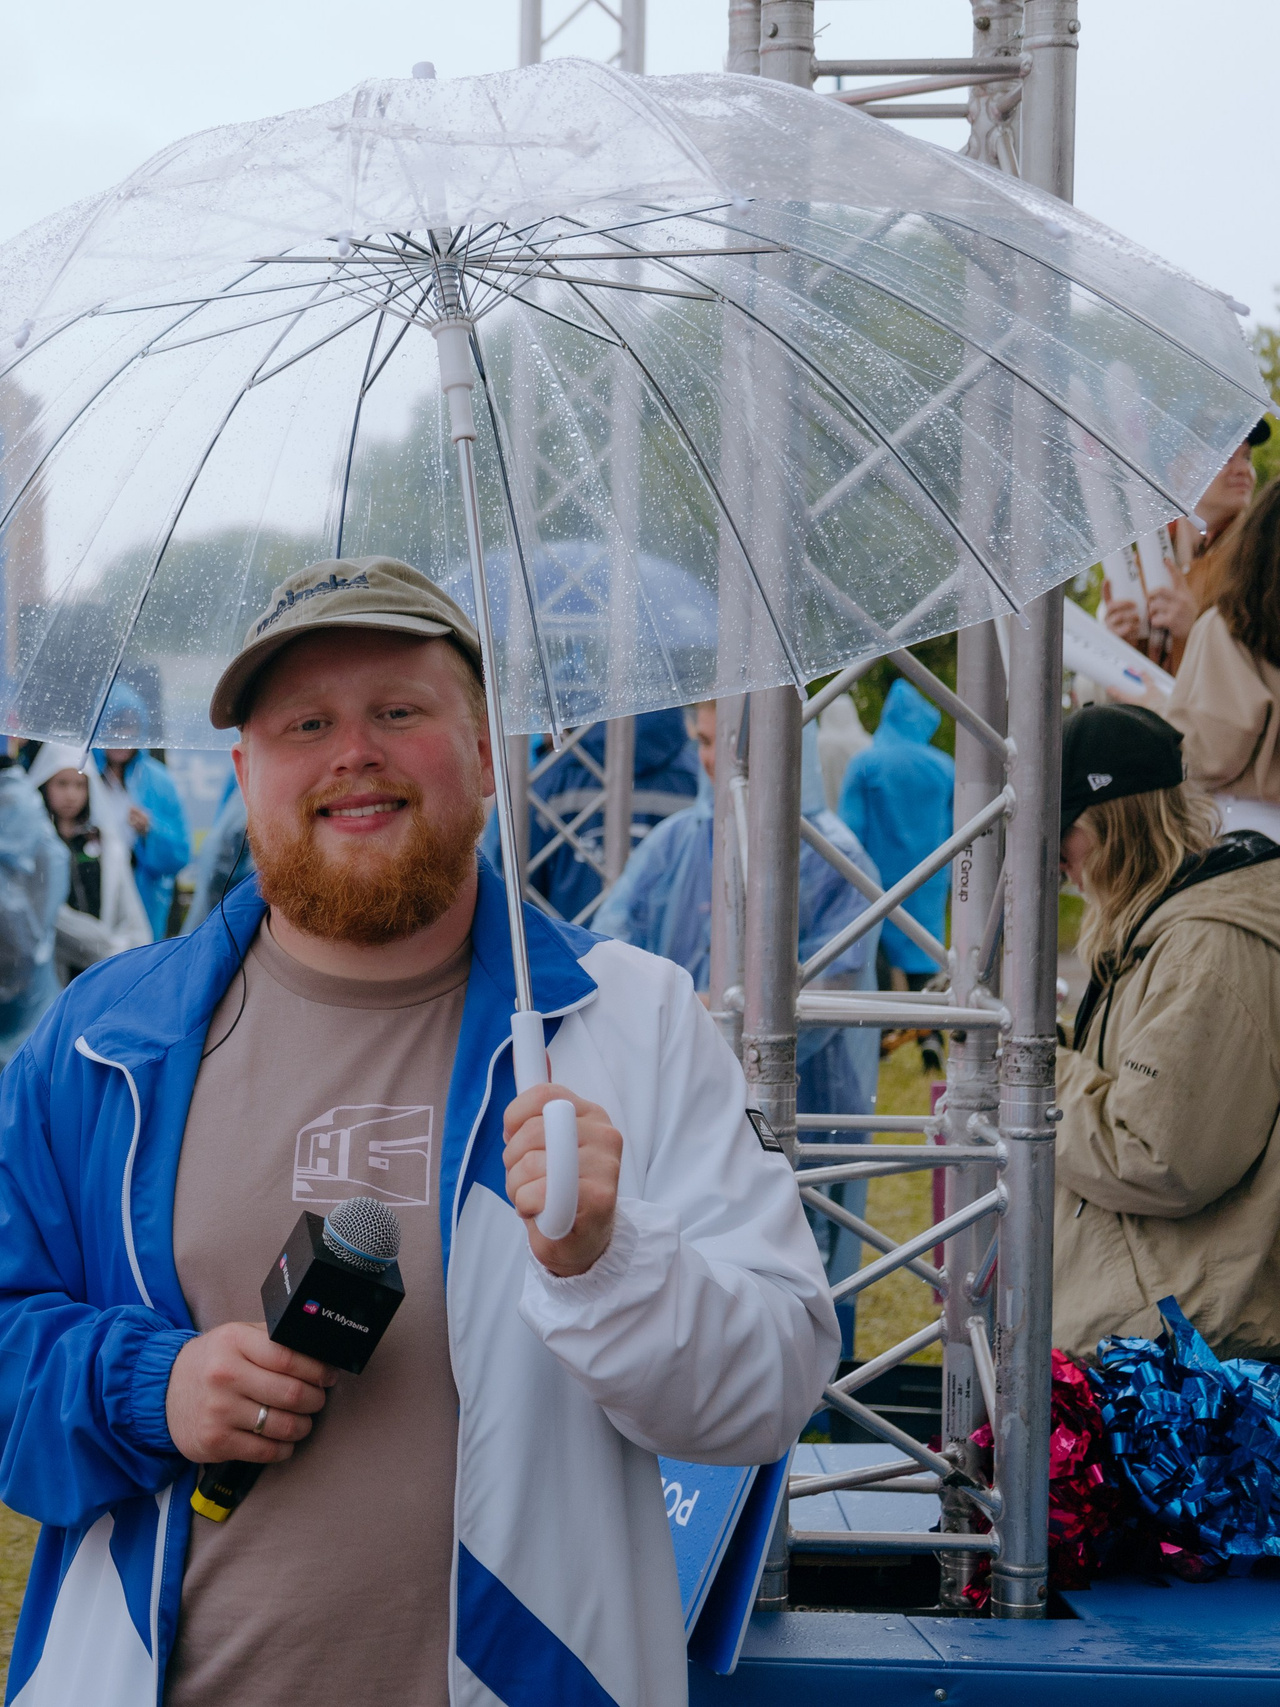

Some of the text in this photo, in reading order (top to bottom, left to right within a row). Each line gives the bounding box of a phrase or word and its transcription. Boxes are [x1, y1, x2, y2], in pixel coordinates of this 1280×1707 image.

[958, 859, 973, 902] Group
[321, 1307, 370, 1333] VK Музыка
